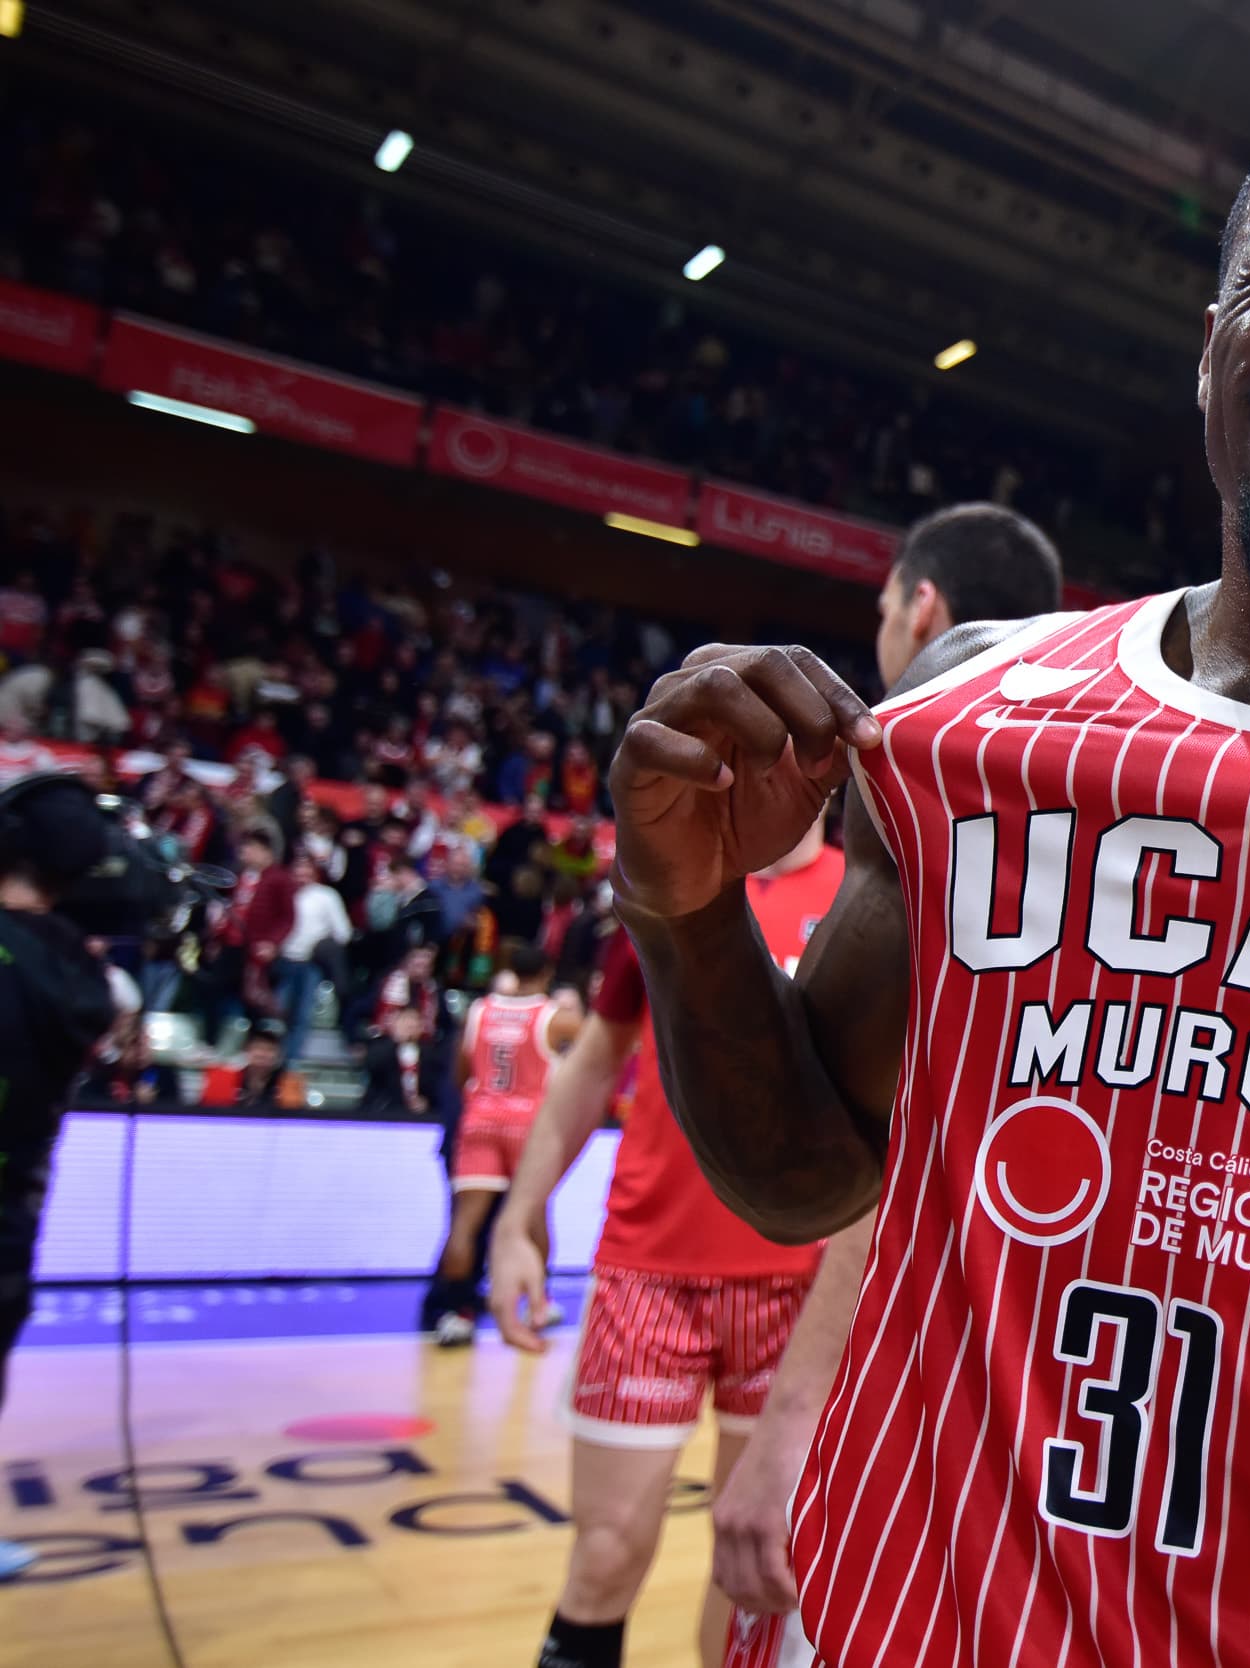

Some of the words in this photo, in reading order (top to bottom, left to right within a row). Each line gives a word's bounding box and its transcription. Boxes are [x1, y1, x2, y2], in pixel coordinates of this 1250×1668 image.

[1147, 1138, 1204, 1167] Costa
[1130, 1210, 1186, 1255] DE
[1037, 1278, 1225, 1559] 31
